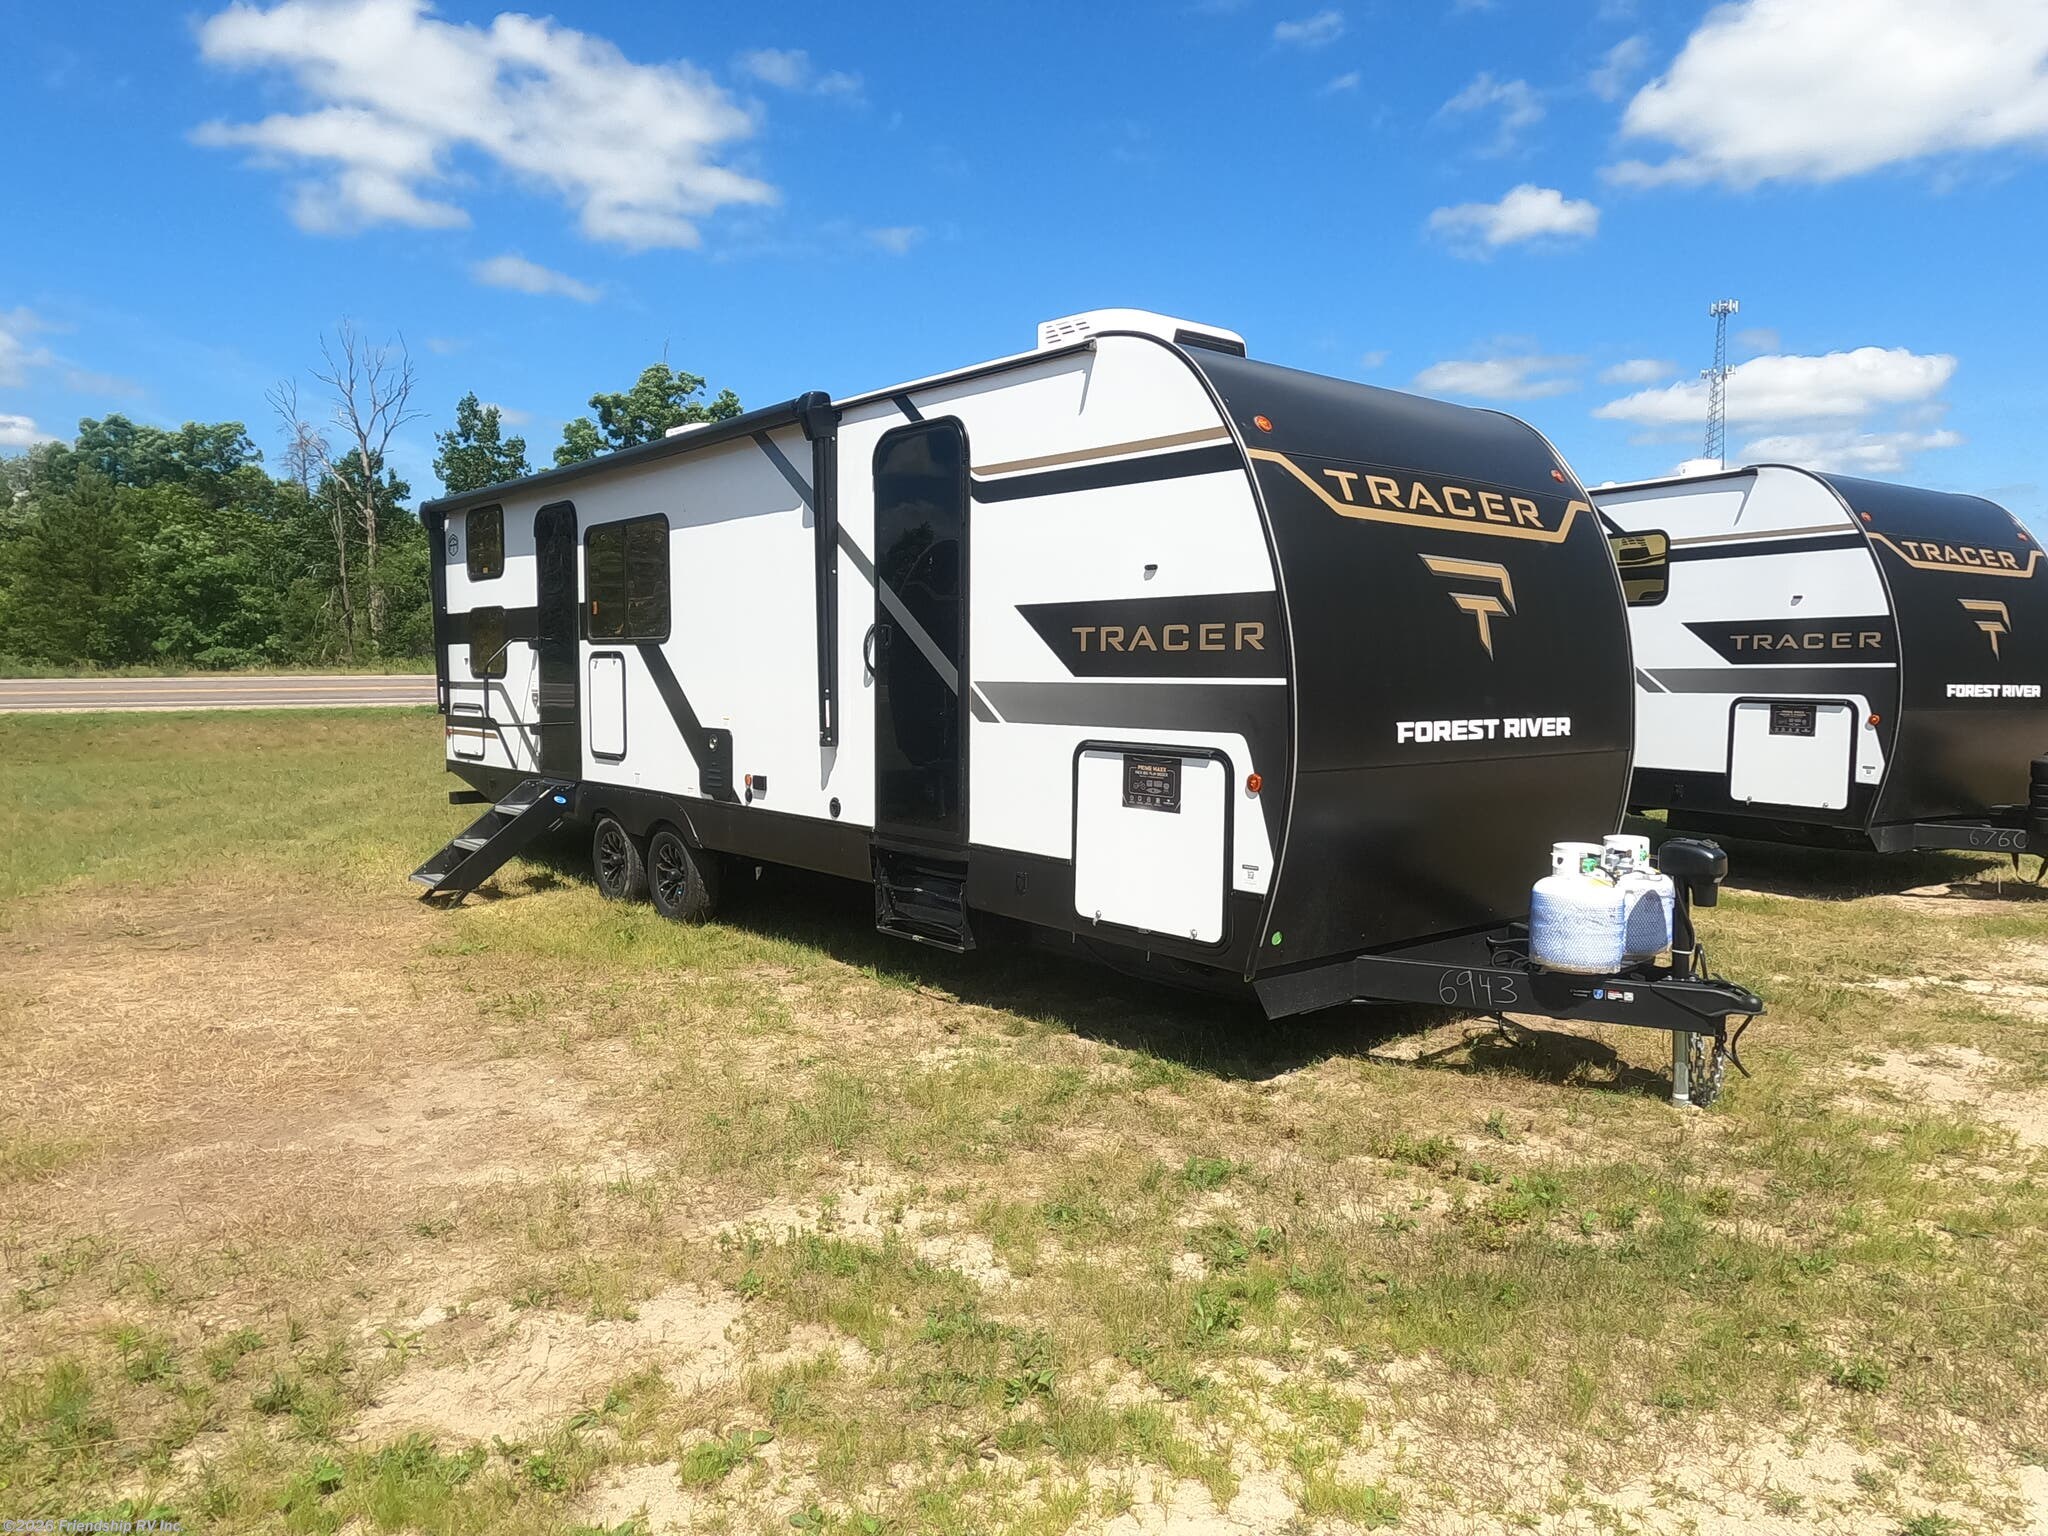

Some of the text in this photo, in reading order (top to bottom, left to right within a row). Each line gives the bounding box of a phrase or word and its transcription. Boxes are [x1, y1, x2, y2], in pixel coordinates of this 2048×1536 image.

[1322, 468, 1545, 528] TRACER
[1900, 540, 2020, 570] TRACER
[1071, 621, 1265, 652] TRACER
[1729, 631, 1883, 651] TRACER
[1946, 684, 2041, 698] FOREST RIVER
[1395, 716, 1571, 744] FOREST RIVER
[1438, 969, 1518, 1006] 6943
